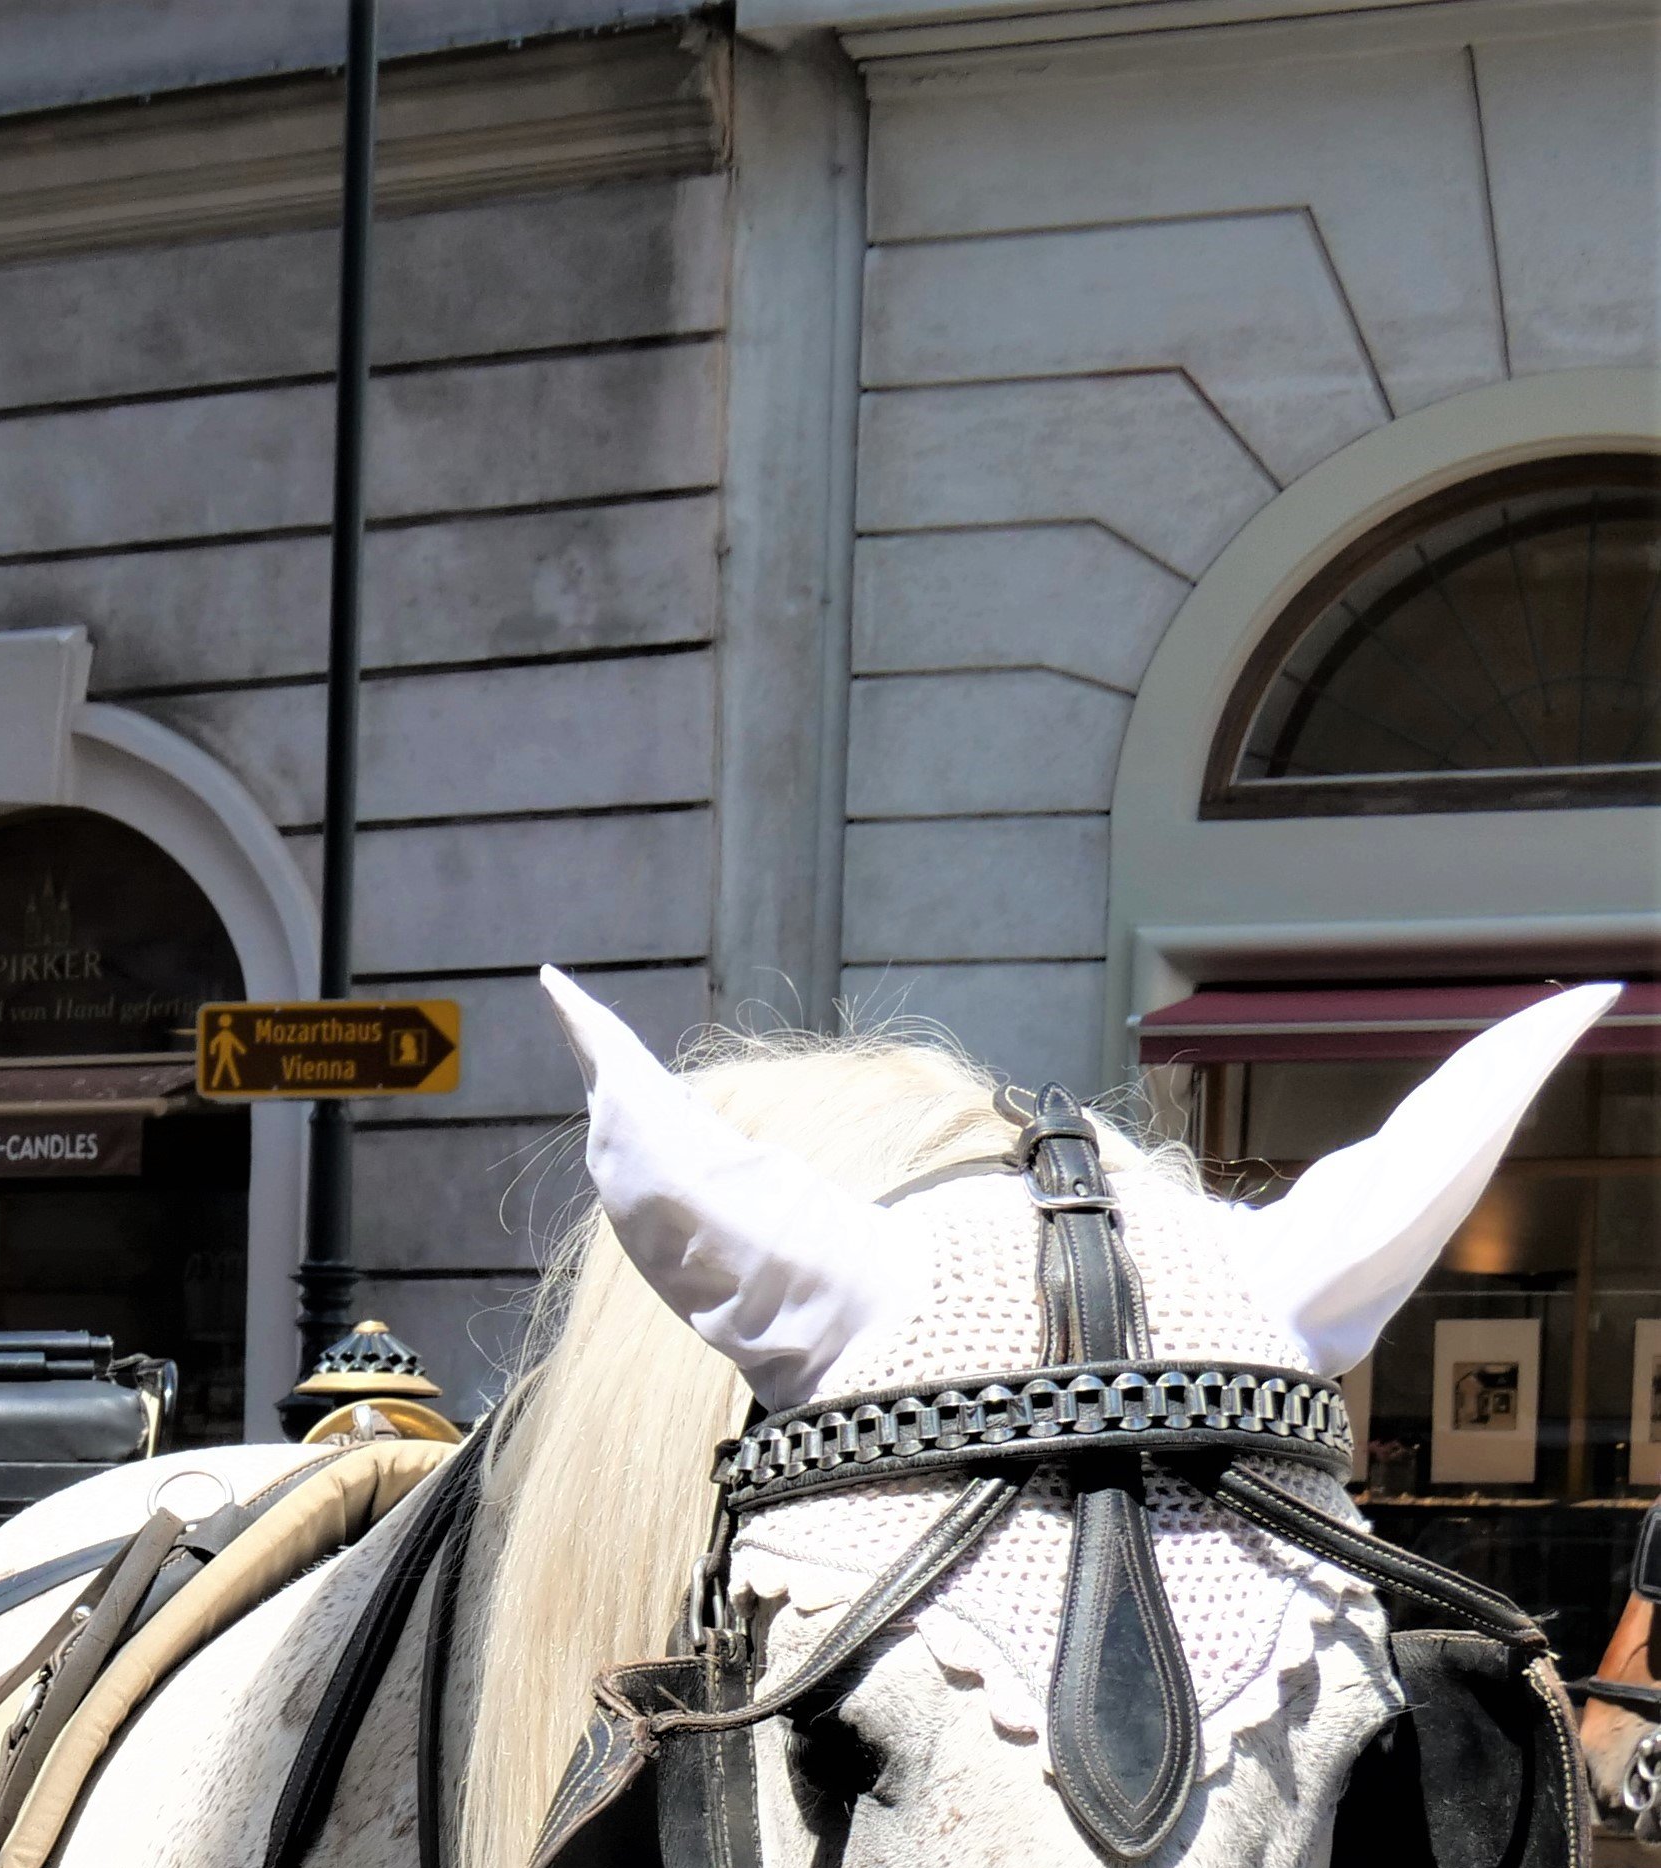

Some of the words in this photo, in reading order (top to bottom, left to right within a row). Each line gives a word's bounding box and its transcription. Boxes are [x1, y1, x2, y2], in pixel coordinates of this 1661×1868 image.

[10, 1004, 46, 1022] von
[54, 995, 115, 1021] Hand
[255, 1018, 383, 1043] Mozarthaus
[280, 1054, 358, 1081] Vienna
